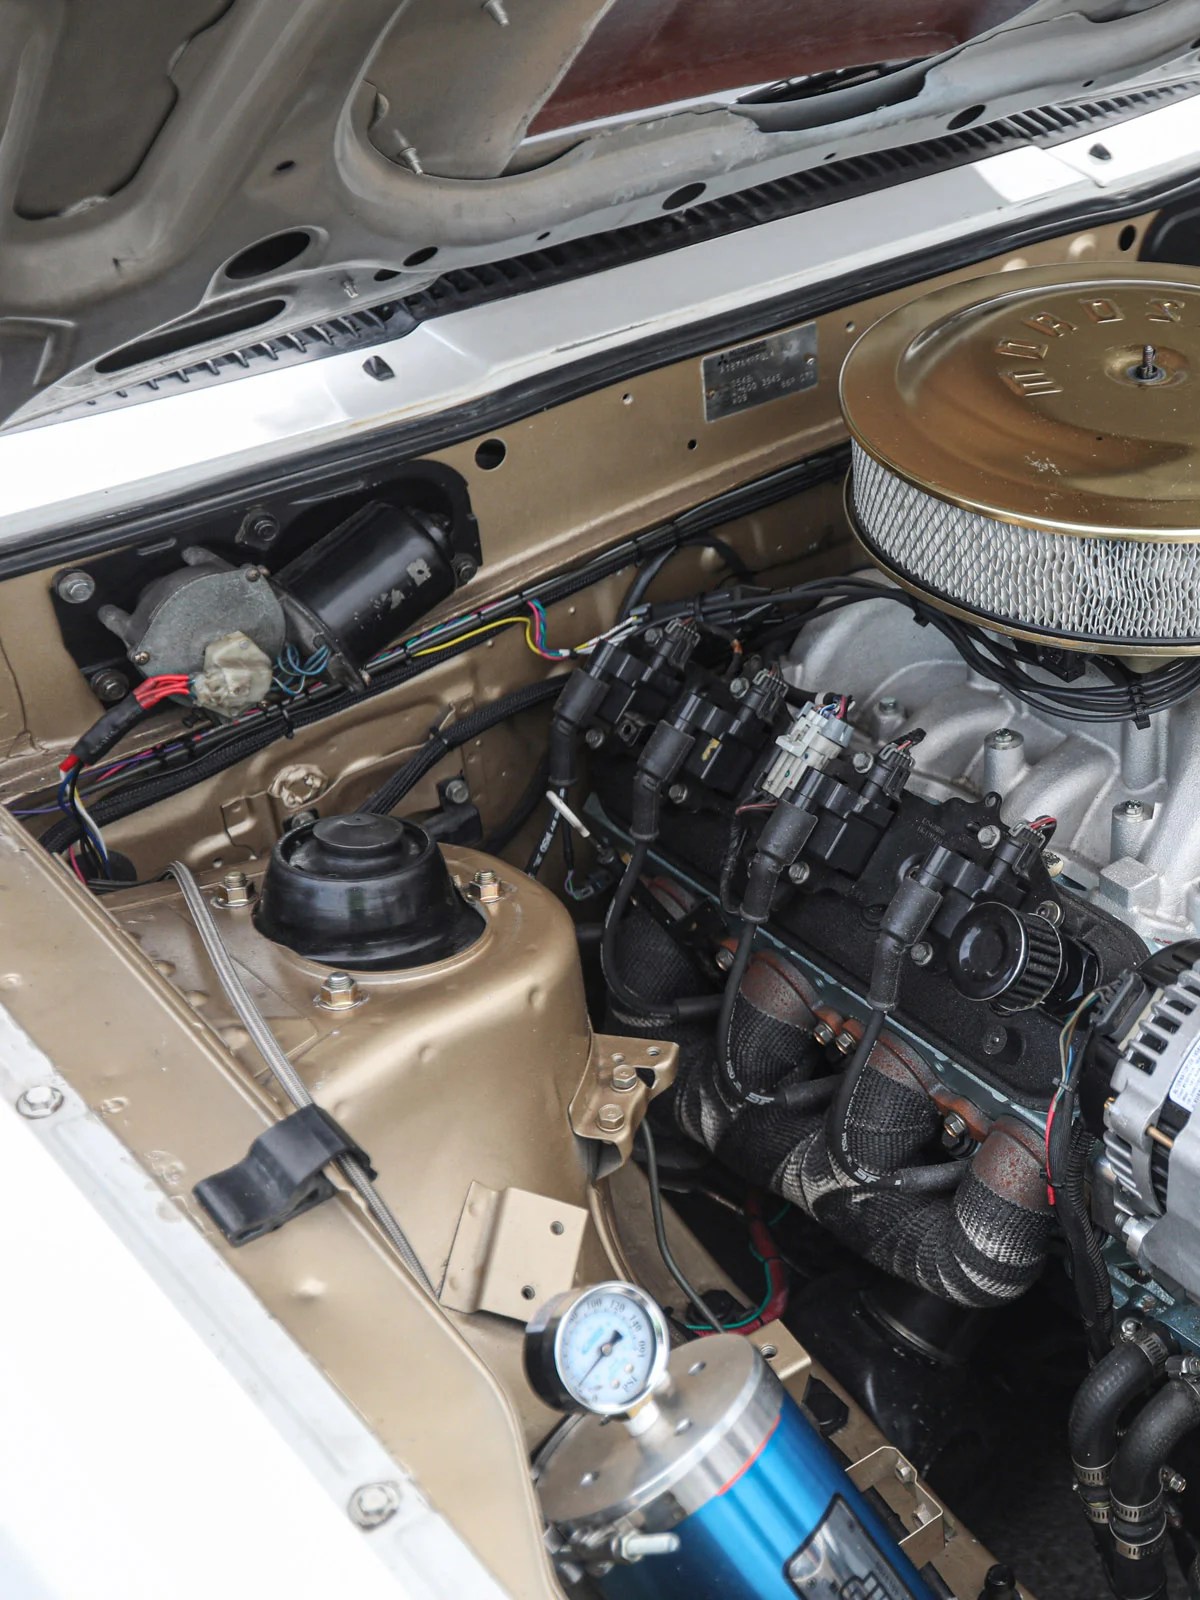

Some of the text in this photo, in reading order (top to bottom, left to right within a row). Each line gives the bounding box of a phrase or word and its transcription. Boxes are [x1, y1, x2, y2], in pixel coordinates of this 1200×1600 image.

[588, 1298, 602, 1309] 100
[610, 1299, 625, 1313] 120
[630, 1315, 642, 1332] 140
[636, 1340, 646, 1358] 160
